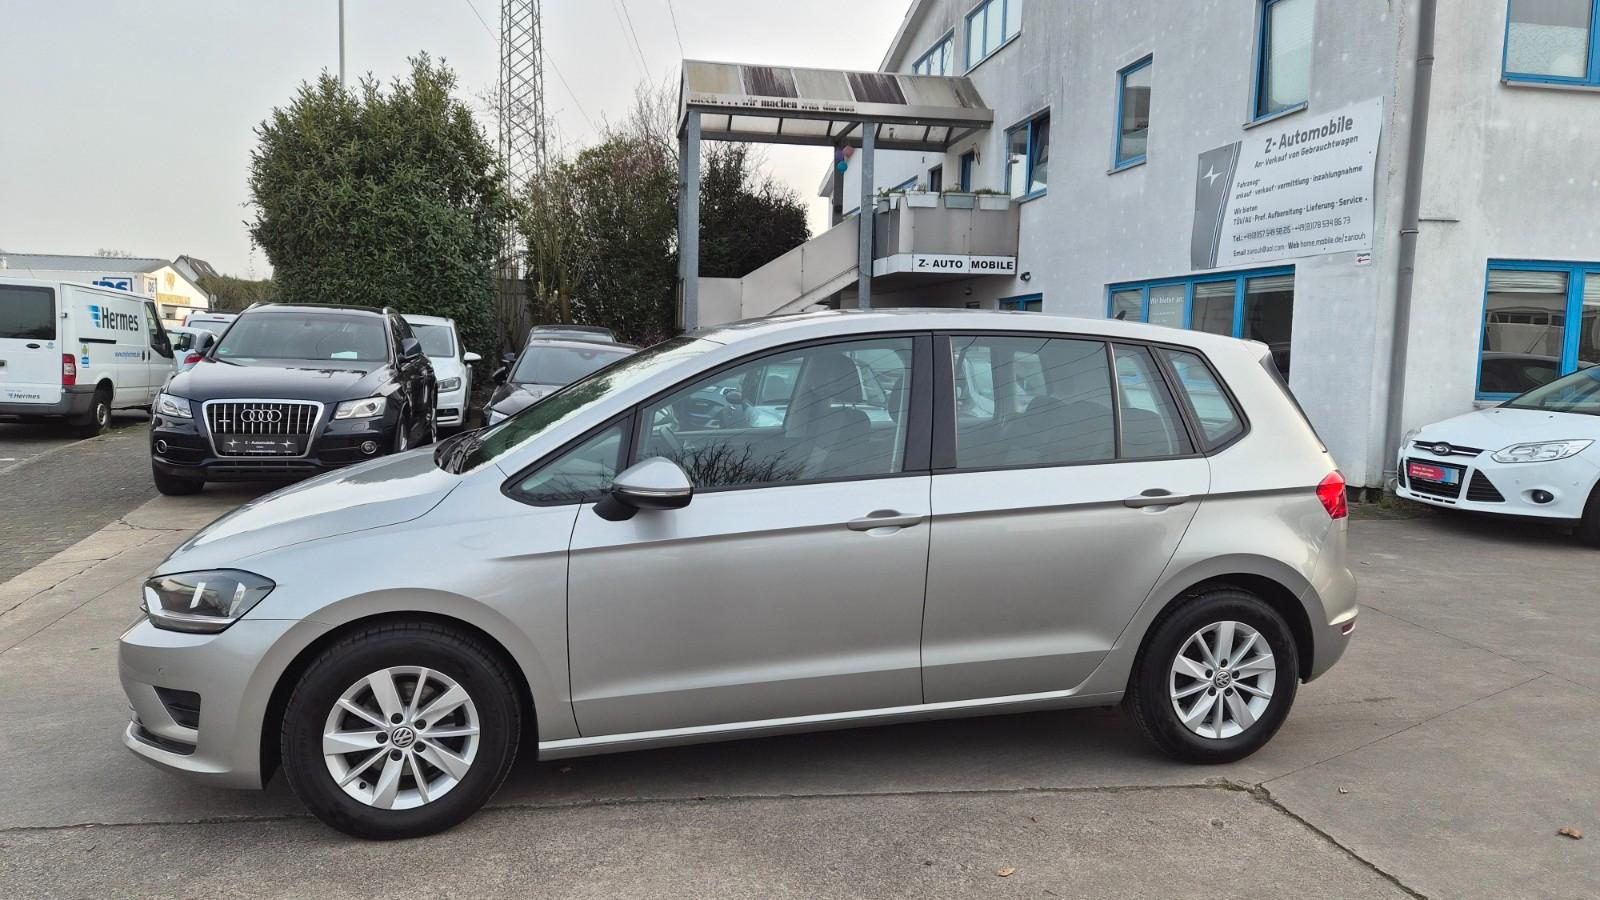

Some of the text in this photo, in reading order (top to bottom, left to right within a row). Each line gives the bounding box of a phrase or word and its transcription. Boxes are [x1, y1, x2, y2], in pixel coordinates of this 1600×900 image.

[760, 98, 798, 109] machen
[1265, 152, 1288, 166] Verkauf
[1288, 151, 1300, 160] von
[1301, 135, 1359, 156] Gebrauchtwagen
[1277, 177, 1310, 190] vermittlung
[1313, 165, 1363, 182] inzahlungnahme
[1305, 201, 1335, 212] Lieferung
[1338, 195, 1363, 206] Service
[932, 259, 963, 269] AUTO
[971, 260, 1014, 270] MOBILE
[101, 306, 139, 332] Hermes
